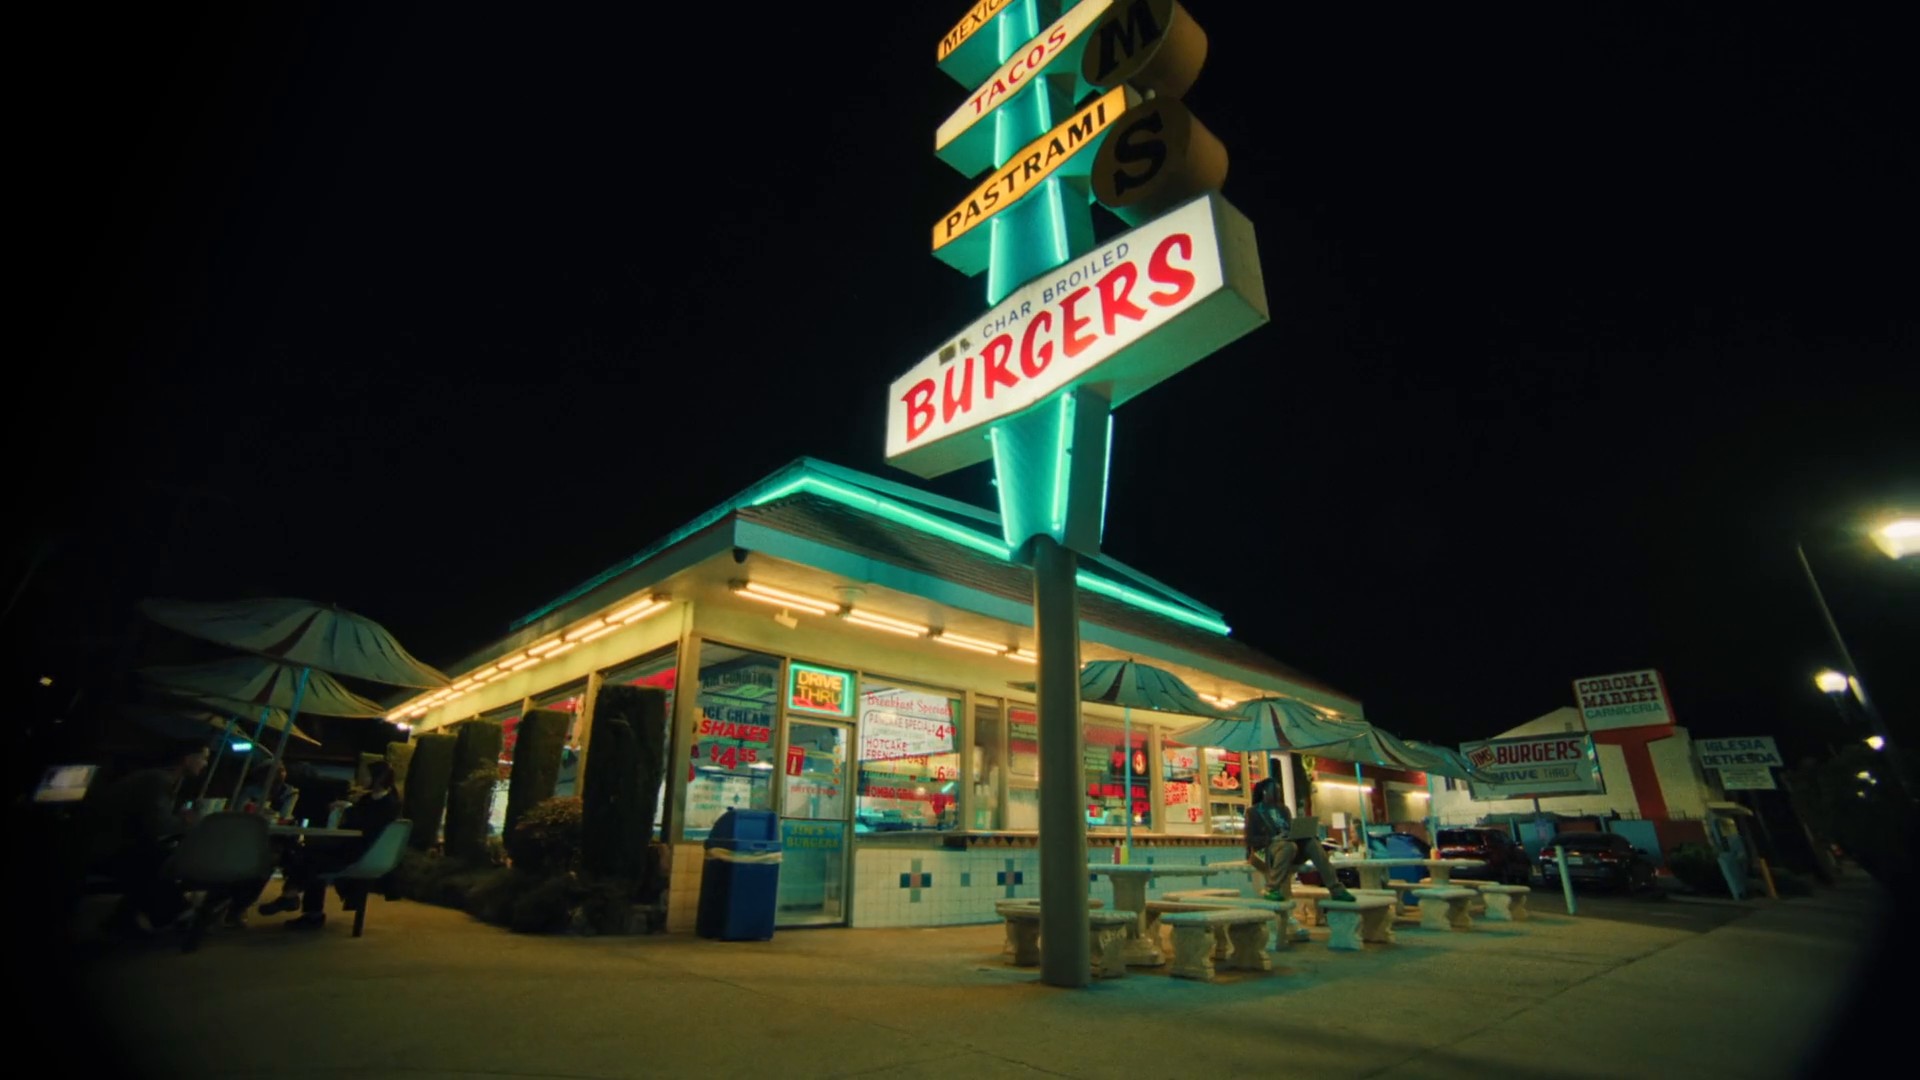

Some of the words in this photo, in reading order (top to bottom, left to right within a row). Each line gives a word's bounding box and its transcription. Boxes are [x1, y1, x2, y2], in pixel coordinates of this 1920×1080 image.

[968, 25, 1067, 115] TACOS
[1112, 110, 1167, 197] S
[945, 103, 1106, 238] PASTRAMI
[984, 301, 1032, 339] CHAR
[1043, 243, 1130, 304] BROILED
[902, 233, 1197, 443] BURGERS
[797, 671, 843, 690] DRIVE
[1579, 673, 1655, 695] CORONA
[797, 685, 843, 705] THRU
[1582, 688, 1658, 708] MARKET
[1585, 702, 1663, 720] CARNICERIA
[700, 719, 770, 743] SHAKES
[1496, 741, 1582, 765] BURGERS
[1705, 739, 1766, 751] IGLESIA
